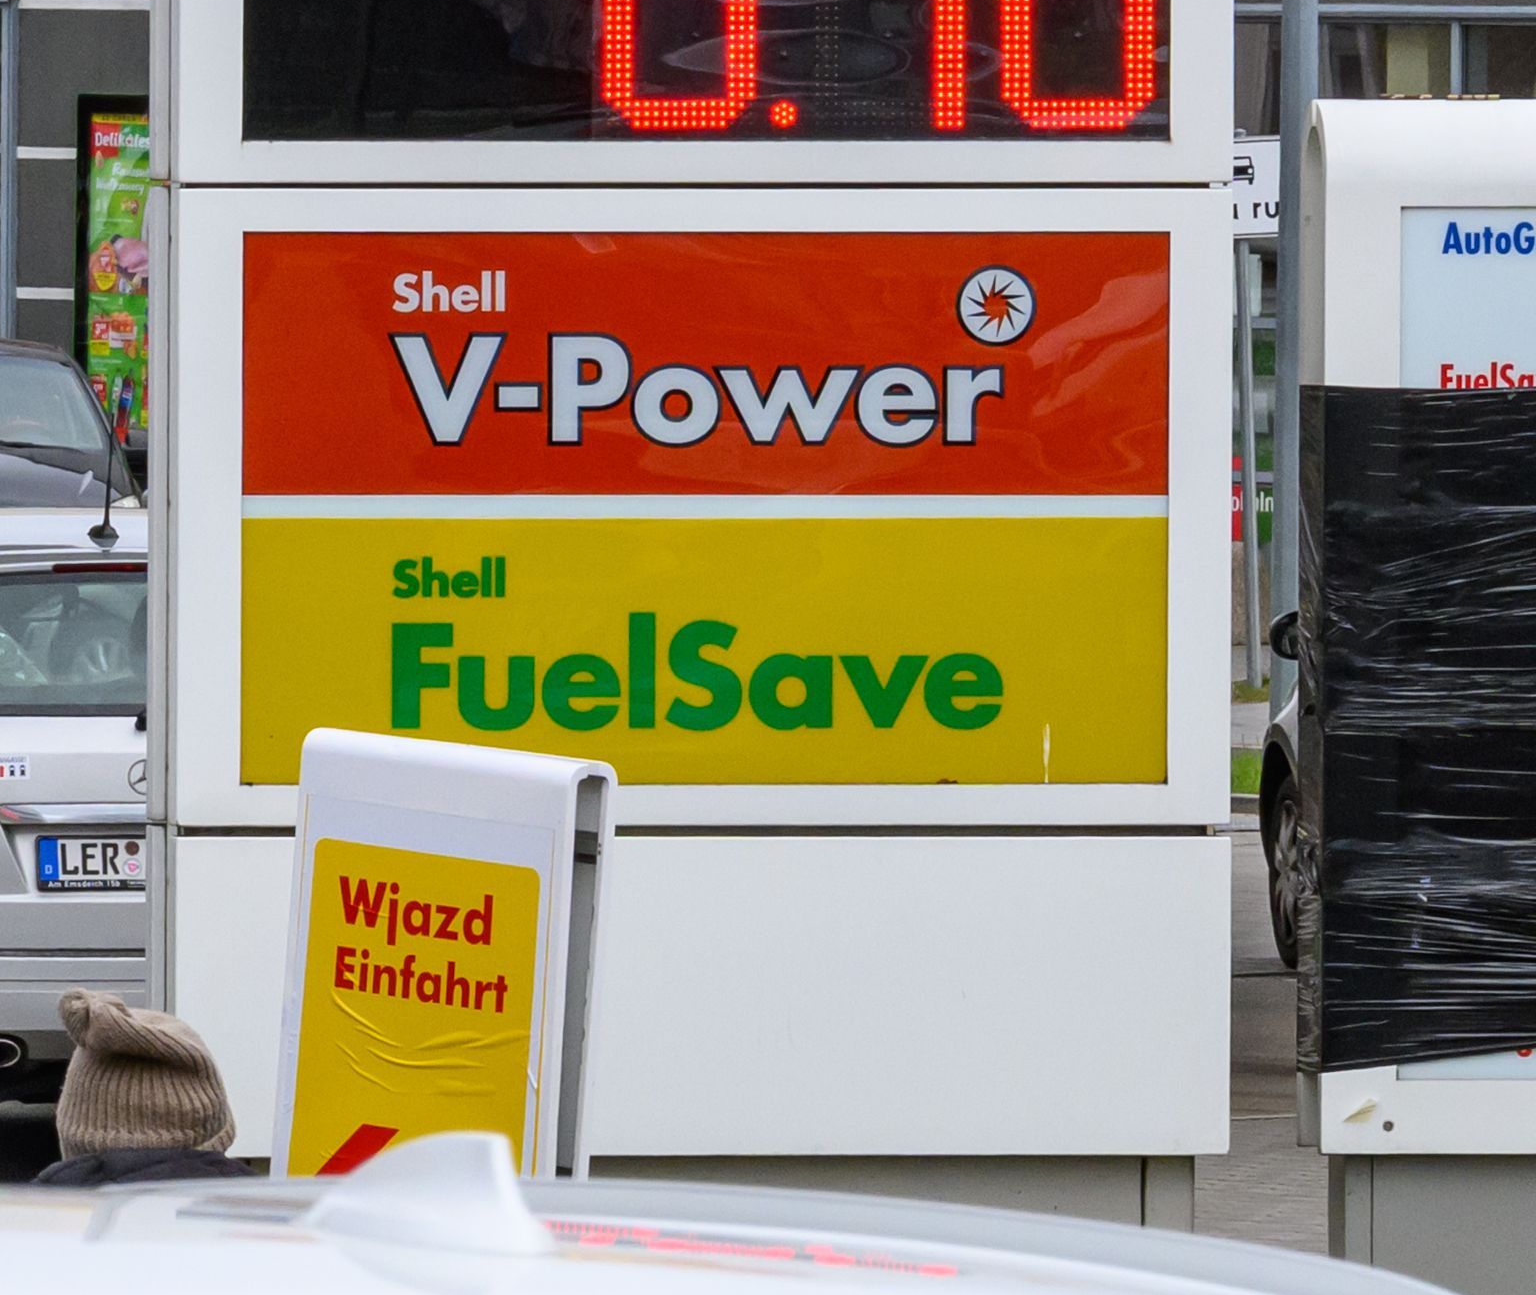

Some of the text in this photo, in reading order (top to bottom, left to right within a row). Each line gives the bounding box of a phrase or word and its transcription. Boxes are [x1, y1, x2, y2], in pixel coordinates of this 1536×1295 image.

[392, 270, 506, 313] Shell
[390, 331, 1005, 447] V-Power
[392, 555, 506, 599] Shell
[390, 611, 1004, 733] FuelSave
[60, 842, 120, 875] LER
[338, 874, 495, 947] Wjazd
[334, 945, 509, 1014] Einfahrt
